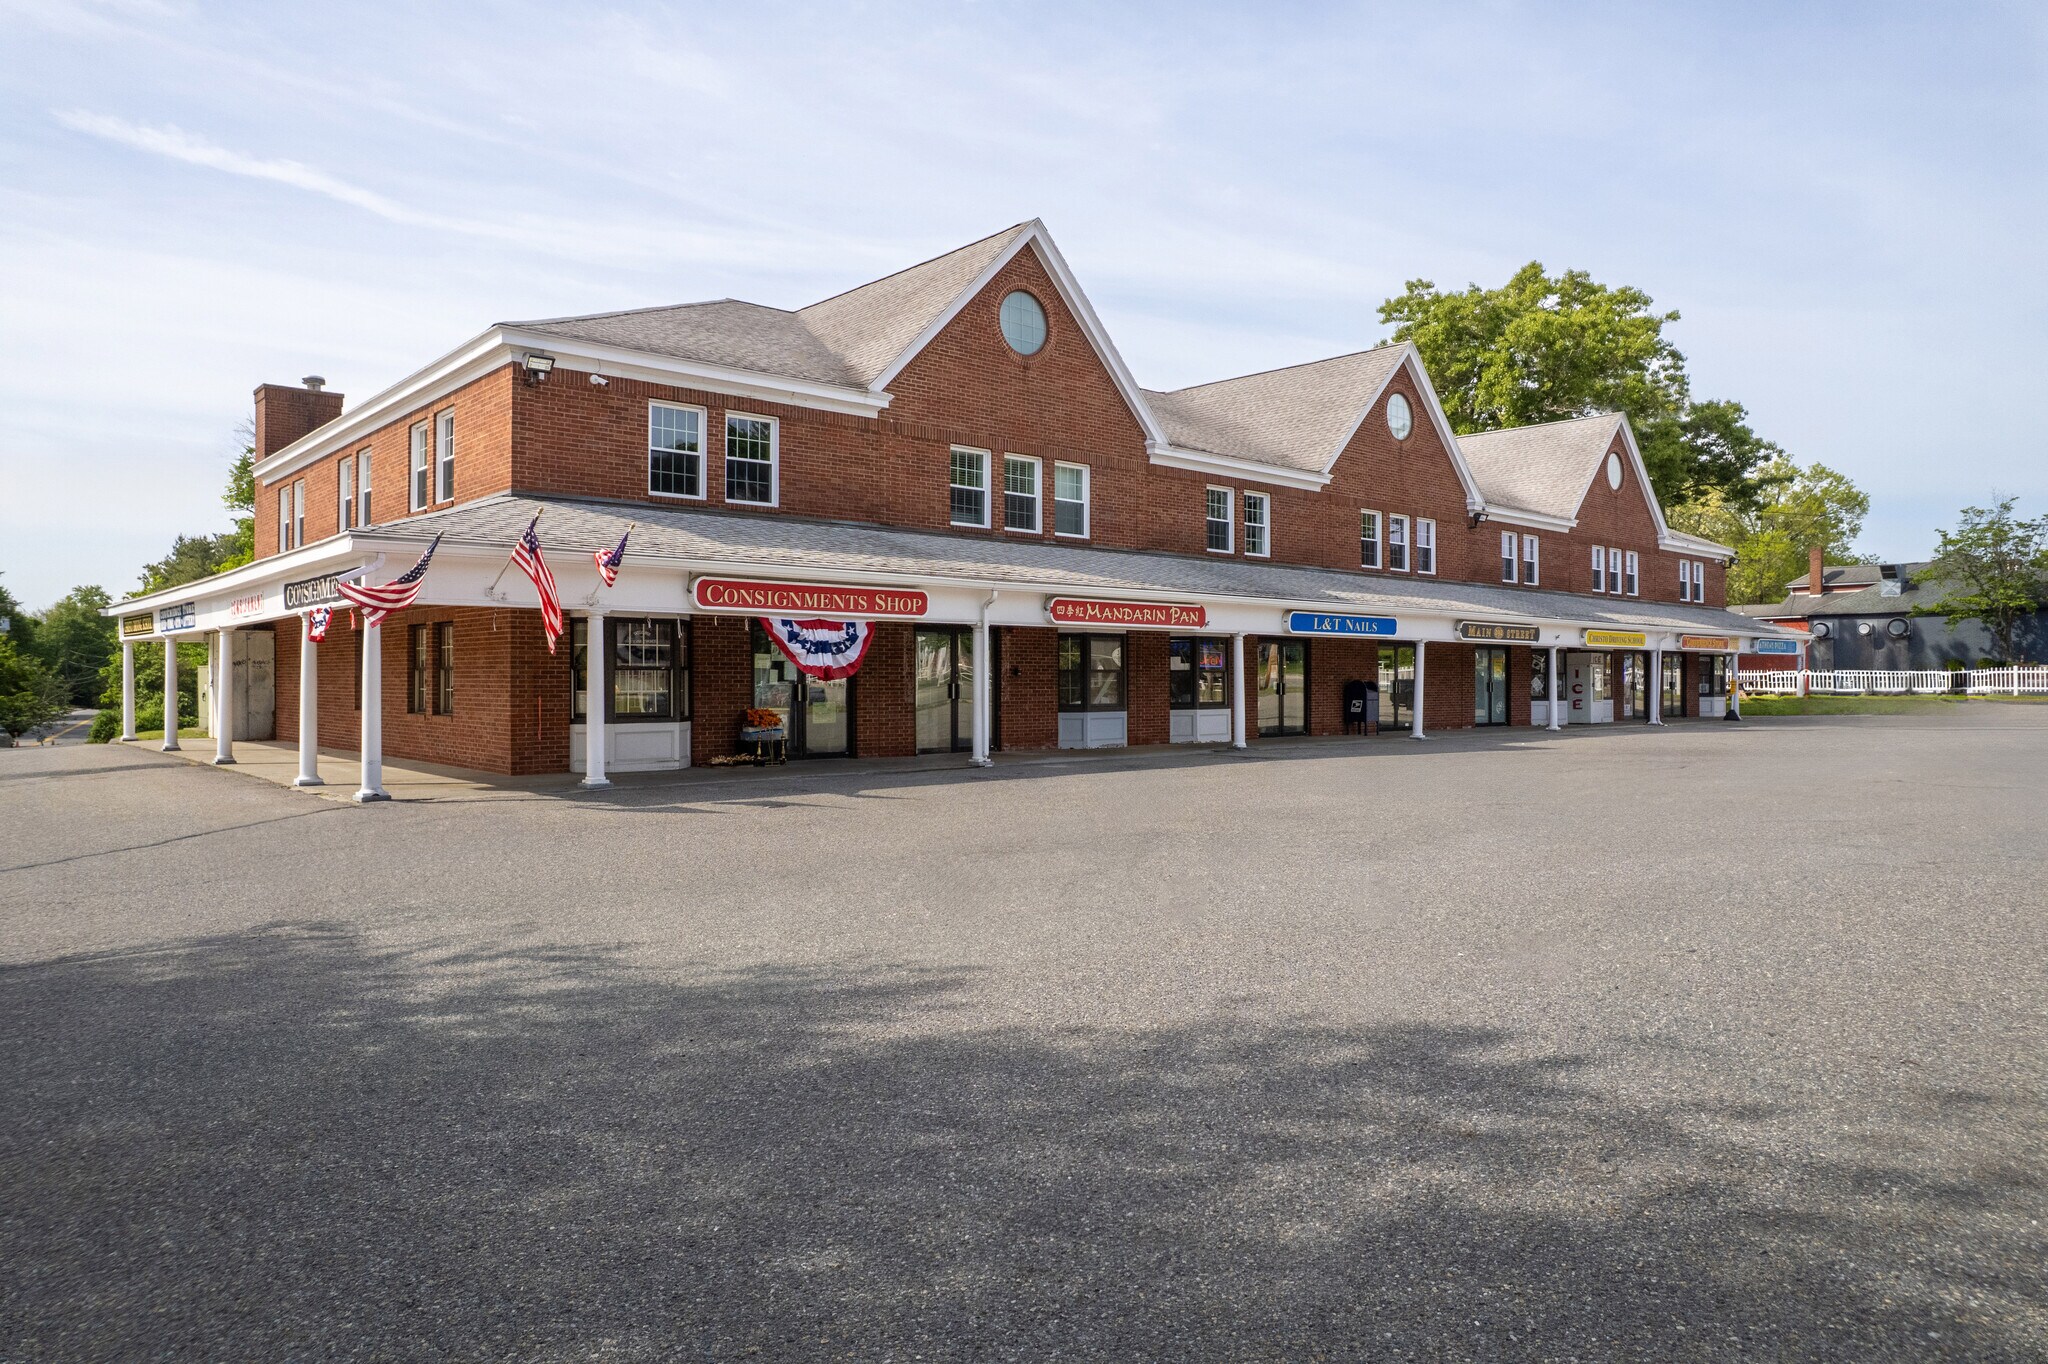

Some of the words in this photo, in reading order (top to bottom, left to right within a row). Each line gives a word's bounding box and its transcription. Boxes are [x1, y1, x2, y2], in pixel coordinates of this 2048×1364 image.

[706, 584, 868, 610] CONSIGNMENTS
[874, 593, 922, 613] SHOP
[1085, 603, 1166, 622] MANDARIN
[1169, 606, 1199, 624] PAN
[1313, 617, 1342, 631] L&T
[1345, 619, 1378, 632] NAILS
[1467, 625, 1492, 638] MAIN
[1506, 628, 1536, 640] STREET
[1608, 634, 1627, 644] DRIVING
[1627, 635, 1645, 646] SCHOOL
[1572, 668, 1584, 710] ICE
